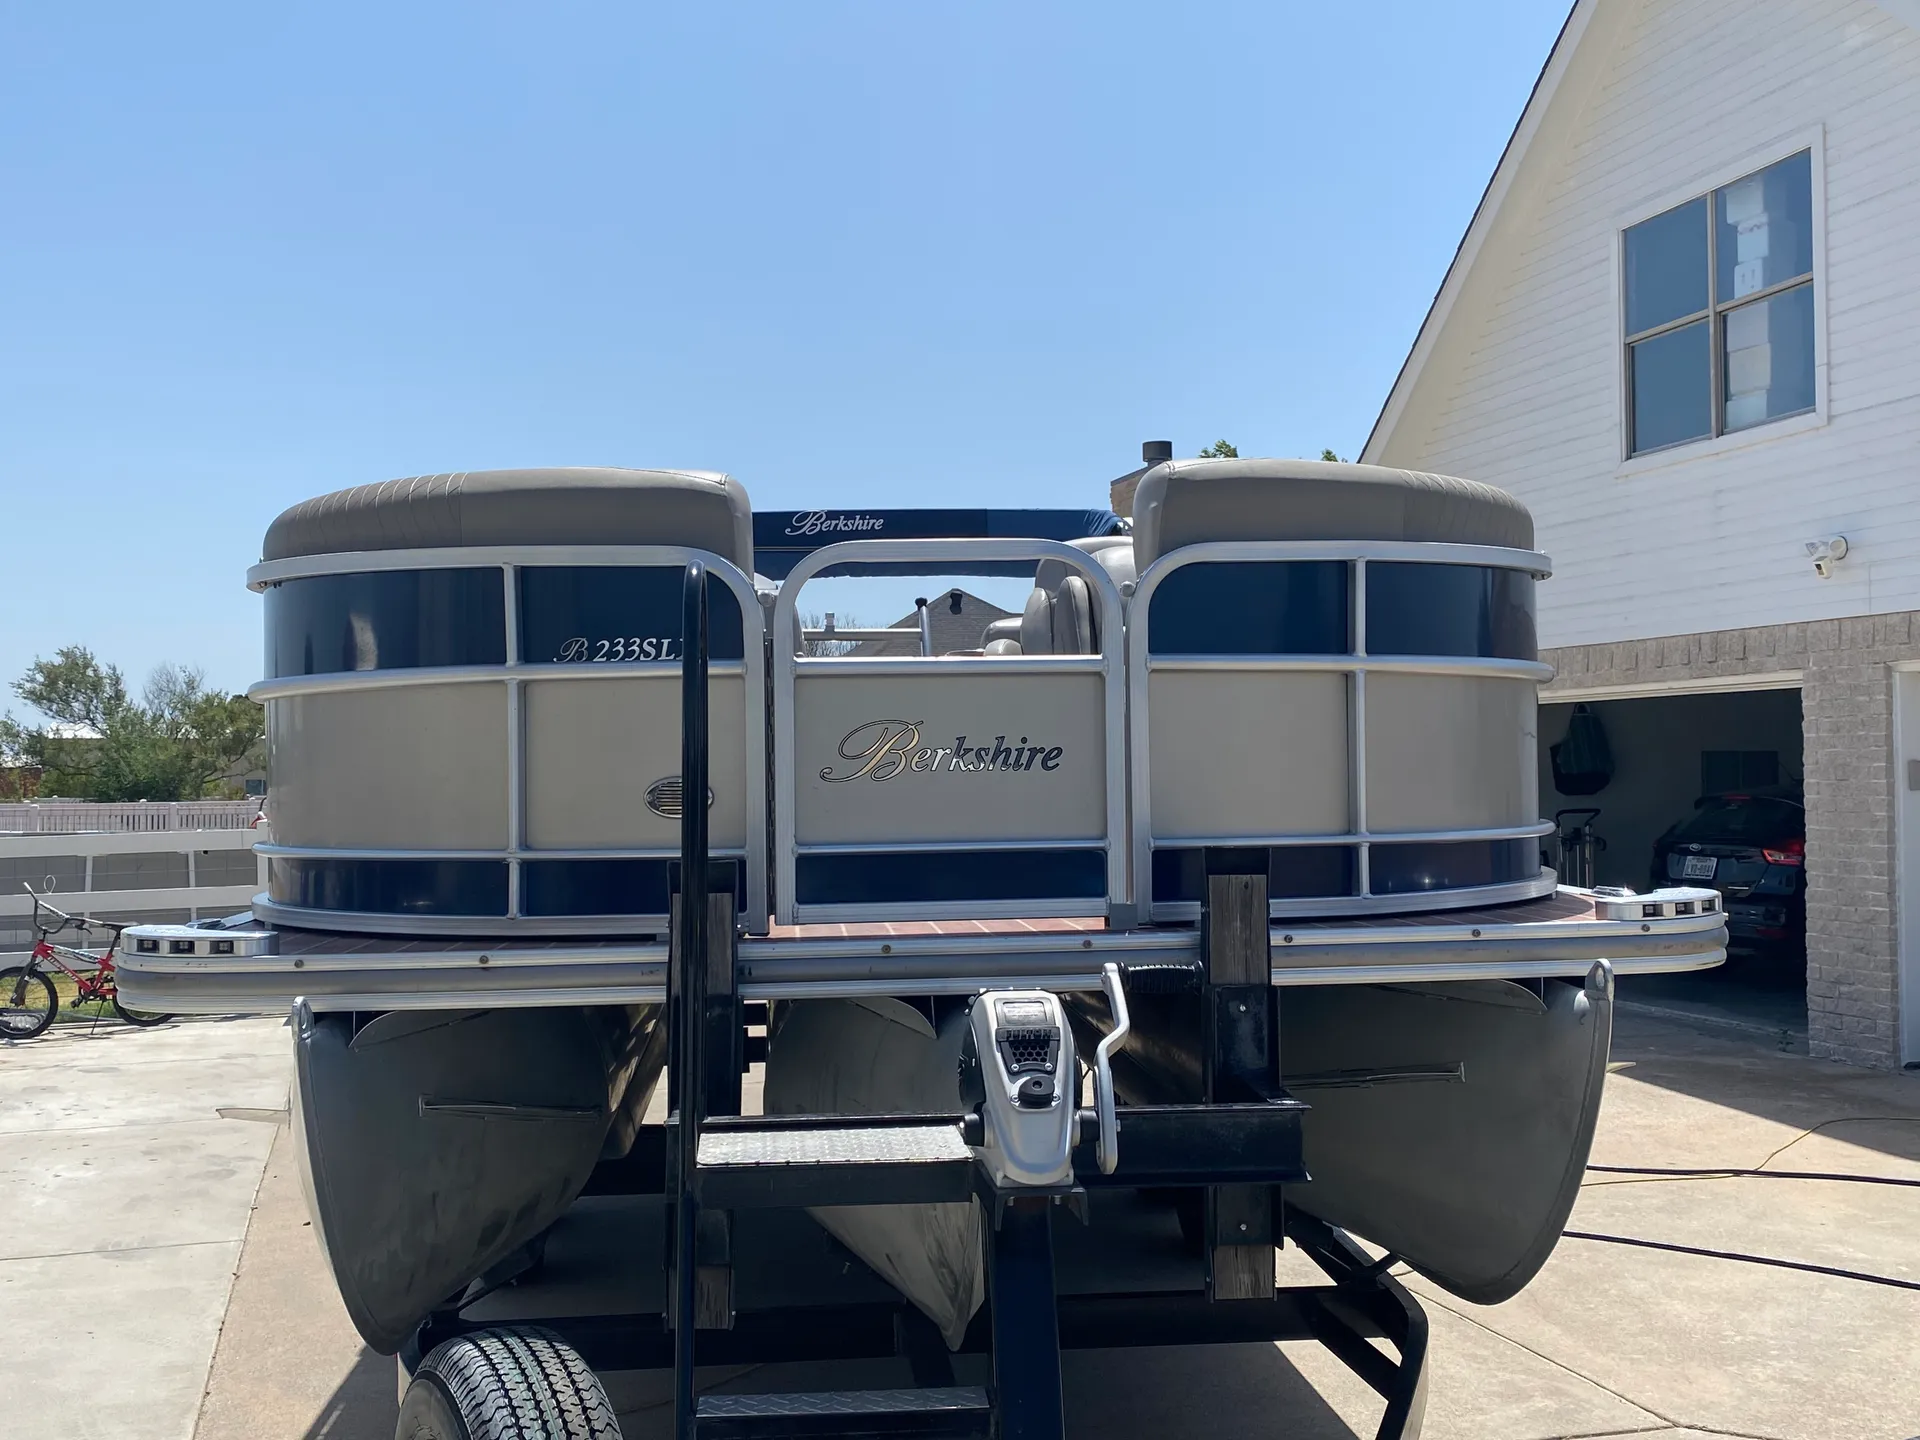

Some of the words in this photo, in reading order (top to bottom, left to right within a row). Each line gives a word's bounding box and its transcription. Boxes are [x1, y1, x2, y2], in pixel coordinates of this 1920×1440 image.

[785, 509, 884, 535] Berkshire
[593, 637, 683, 662] 233SL
[820, 719, 1063, 783] Berkshire
